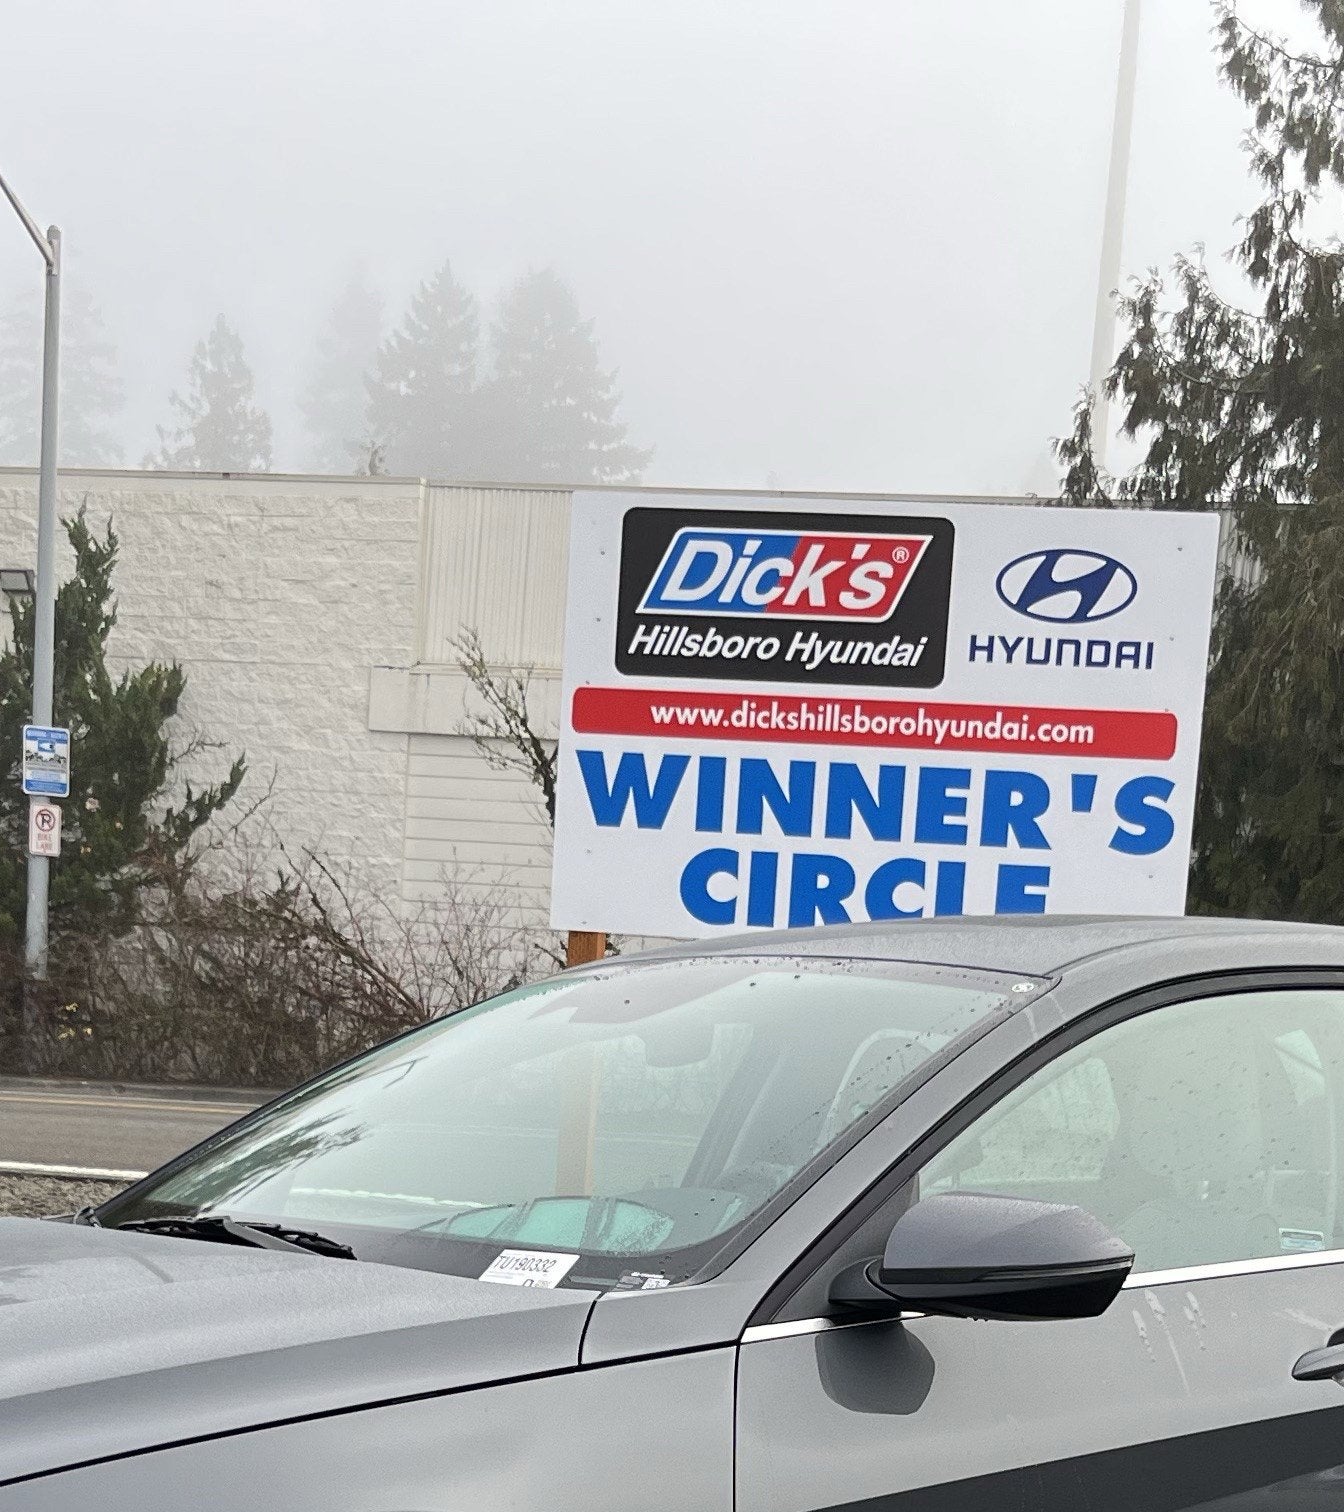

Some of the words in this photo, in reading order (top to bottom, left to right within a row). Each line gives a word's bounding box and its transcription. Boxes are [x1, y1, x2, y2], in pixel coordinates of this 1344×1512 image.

[660, 539, 894, 609] Dick's
[627, 624, 781, 660] Hillsboro
[784, 631, 929, 671] Hyundai
[968, 634, 1154, 670] HYUNDAI
[650, 699, 1094, 745] www.dickshillsborohyundai.com
[576, 749, 1175, 855] WINNER'S
